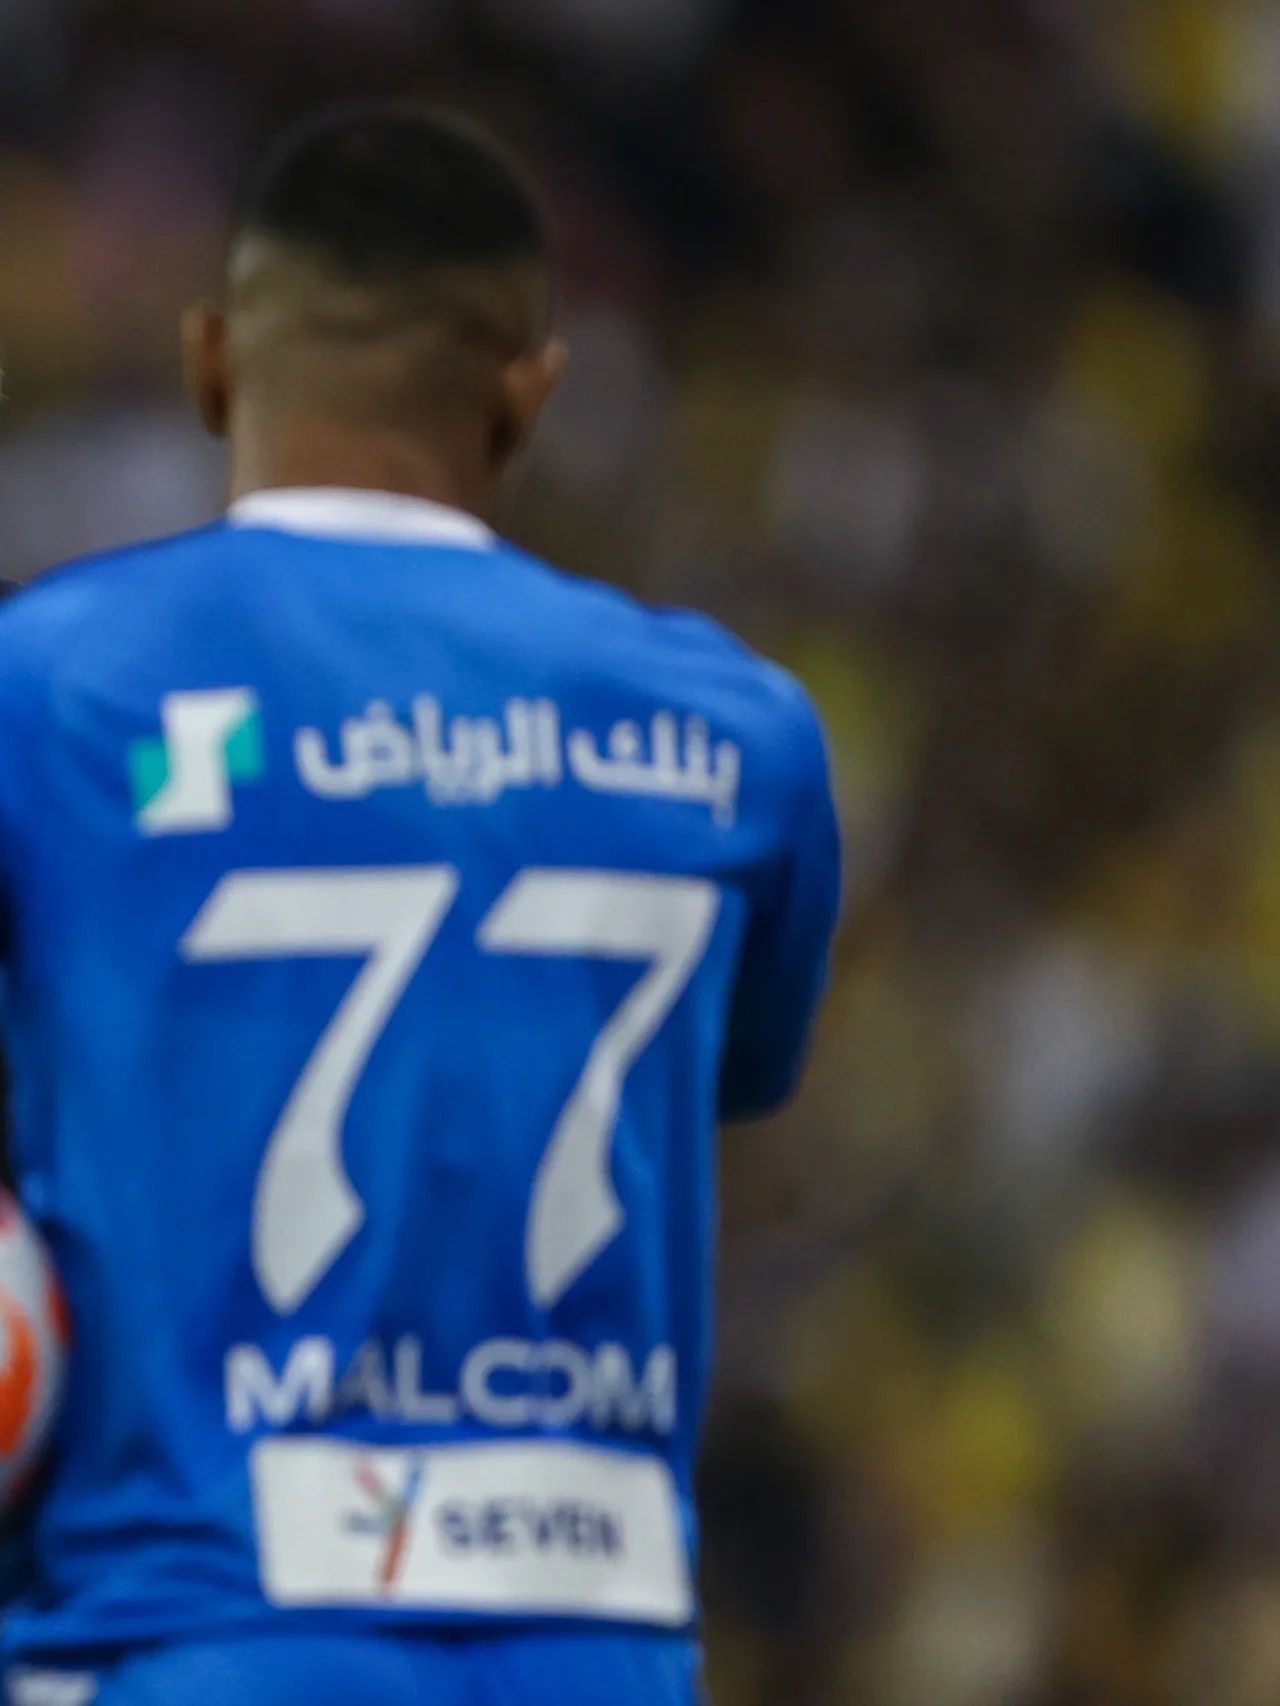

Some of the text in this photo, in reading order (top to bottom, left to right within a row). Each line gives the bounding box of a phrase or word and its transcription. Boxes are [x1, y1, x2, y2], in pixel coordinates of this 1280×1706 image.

[296, 693, 739, 827] بنك الرياض
[180, 864, 720, 1314] 77
[225, 1334, 676, 1434] MALCOM
[436, 1499, 624, 1558] SEVEN
